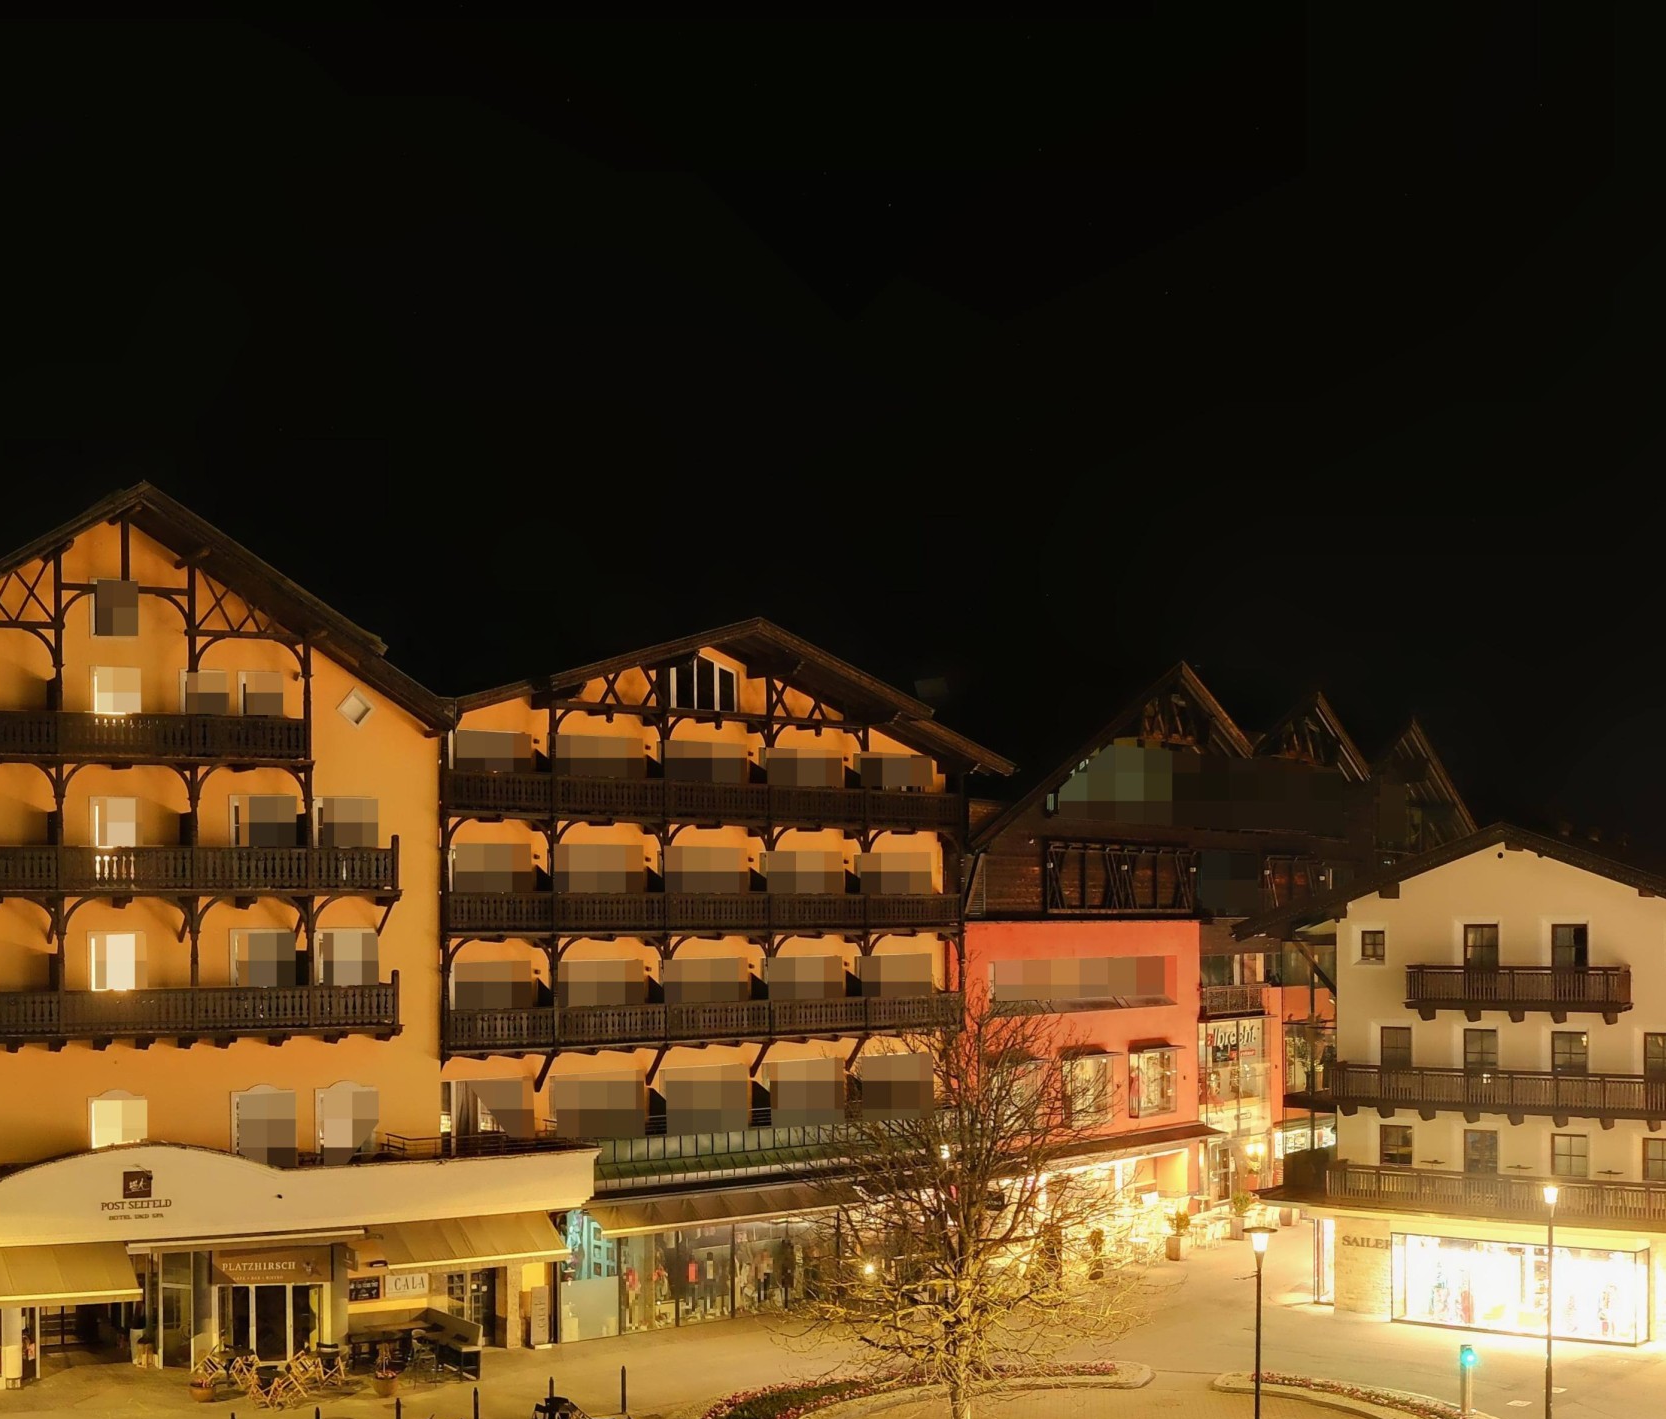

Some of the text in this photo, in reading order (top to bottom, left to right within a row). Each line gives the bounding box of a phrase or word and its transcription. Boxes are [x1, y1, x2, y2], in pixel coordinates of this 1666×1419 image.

[101, 1201, 126, 1211] POST
[222, 1262, 296, 1272] PLATZHIRSCH
[394, 1276, 425, 1291] CALA
